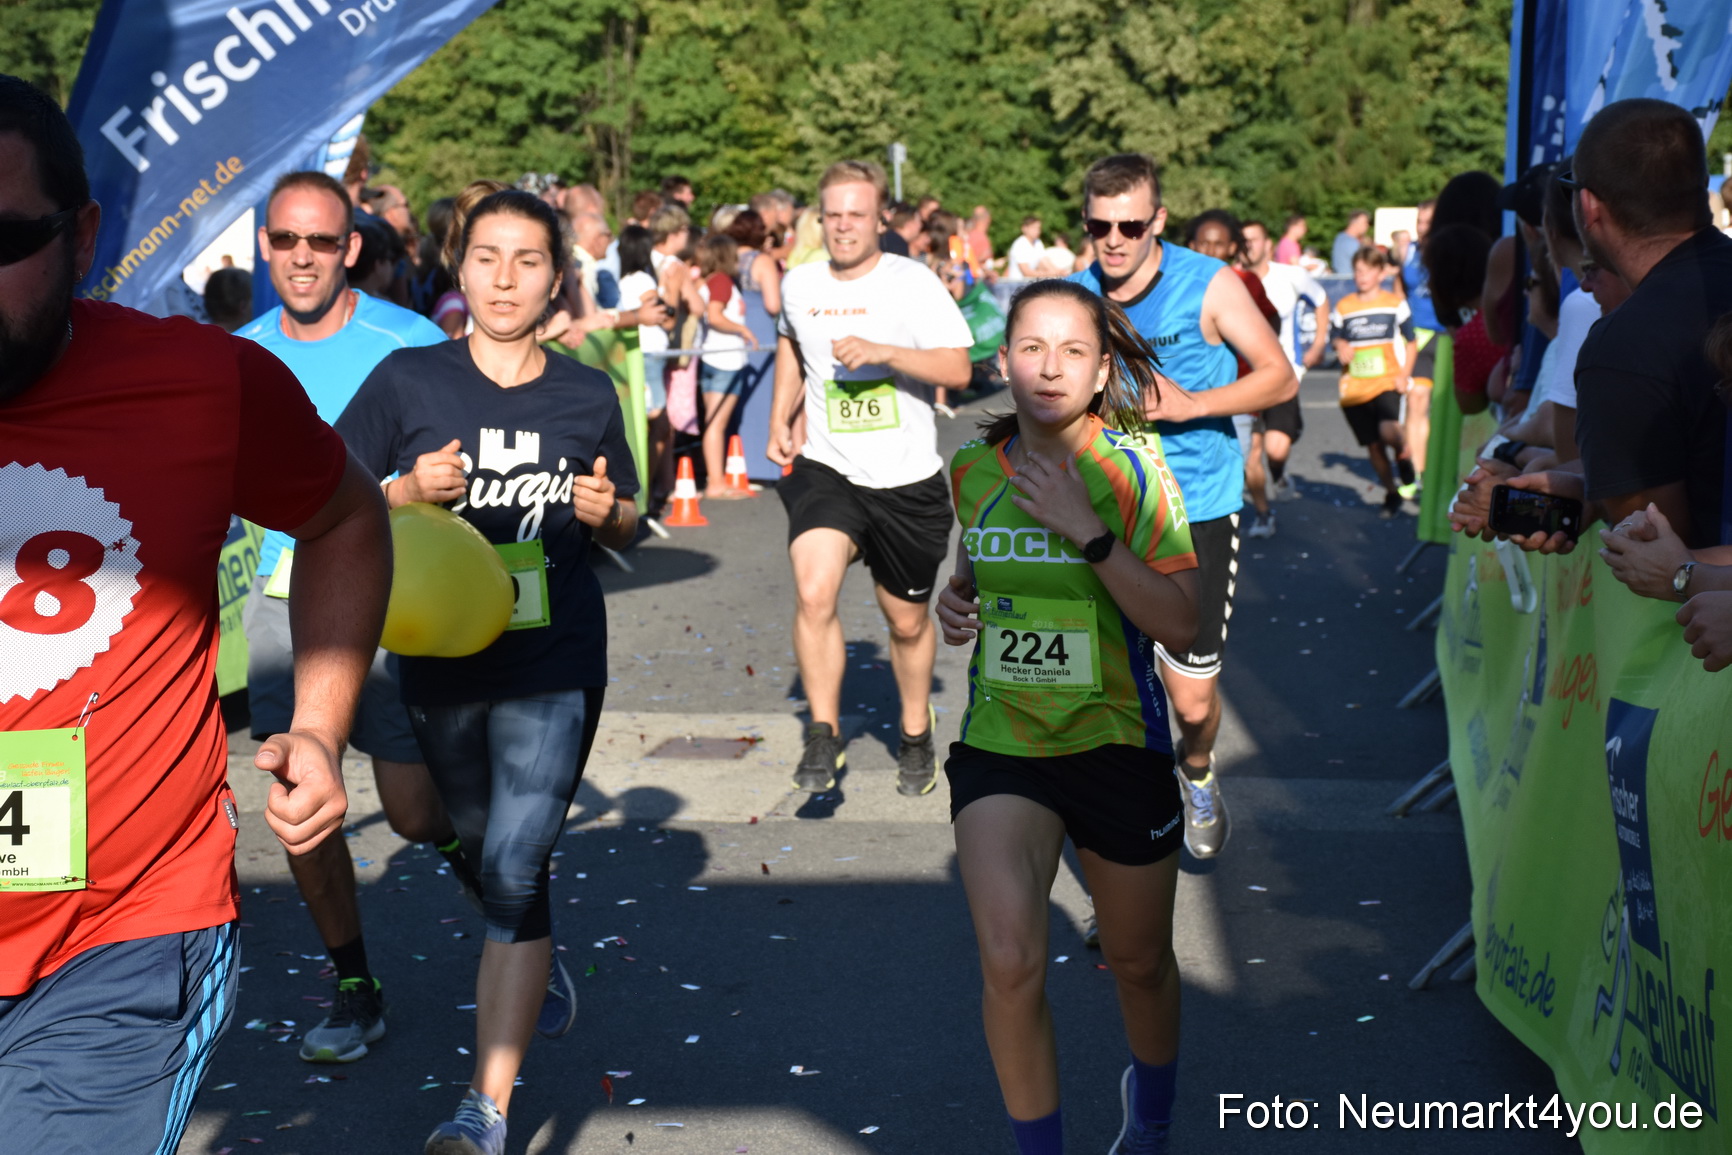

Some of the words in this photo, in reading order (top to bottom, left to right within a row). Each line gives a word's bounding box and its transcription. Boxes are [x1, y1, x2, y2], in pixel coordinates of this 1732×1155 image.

[840, 398, 880, 418] 876
[1032, 620, 1054, 629] 2018
[1000, 629, 1069, 666] 224
[1000, 664, 1031, 675] Hecker
[1034, 667, 1071, 676] Daniela
